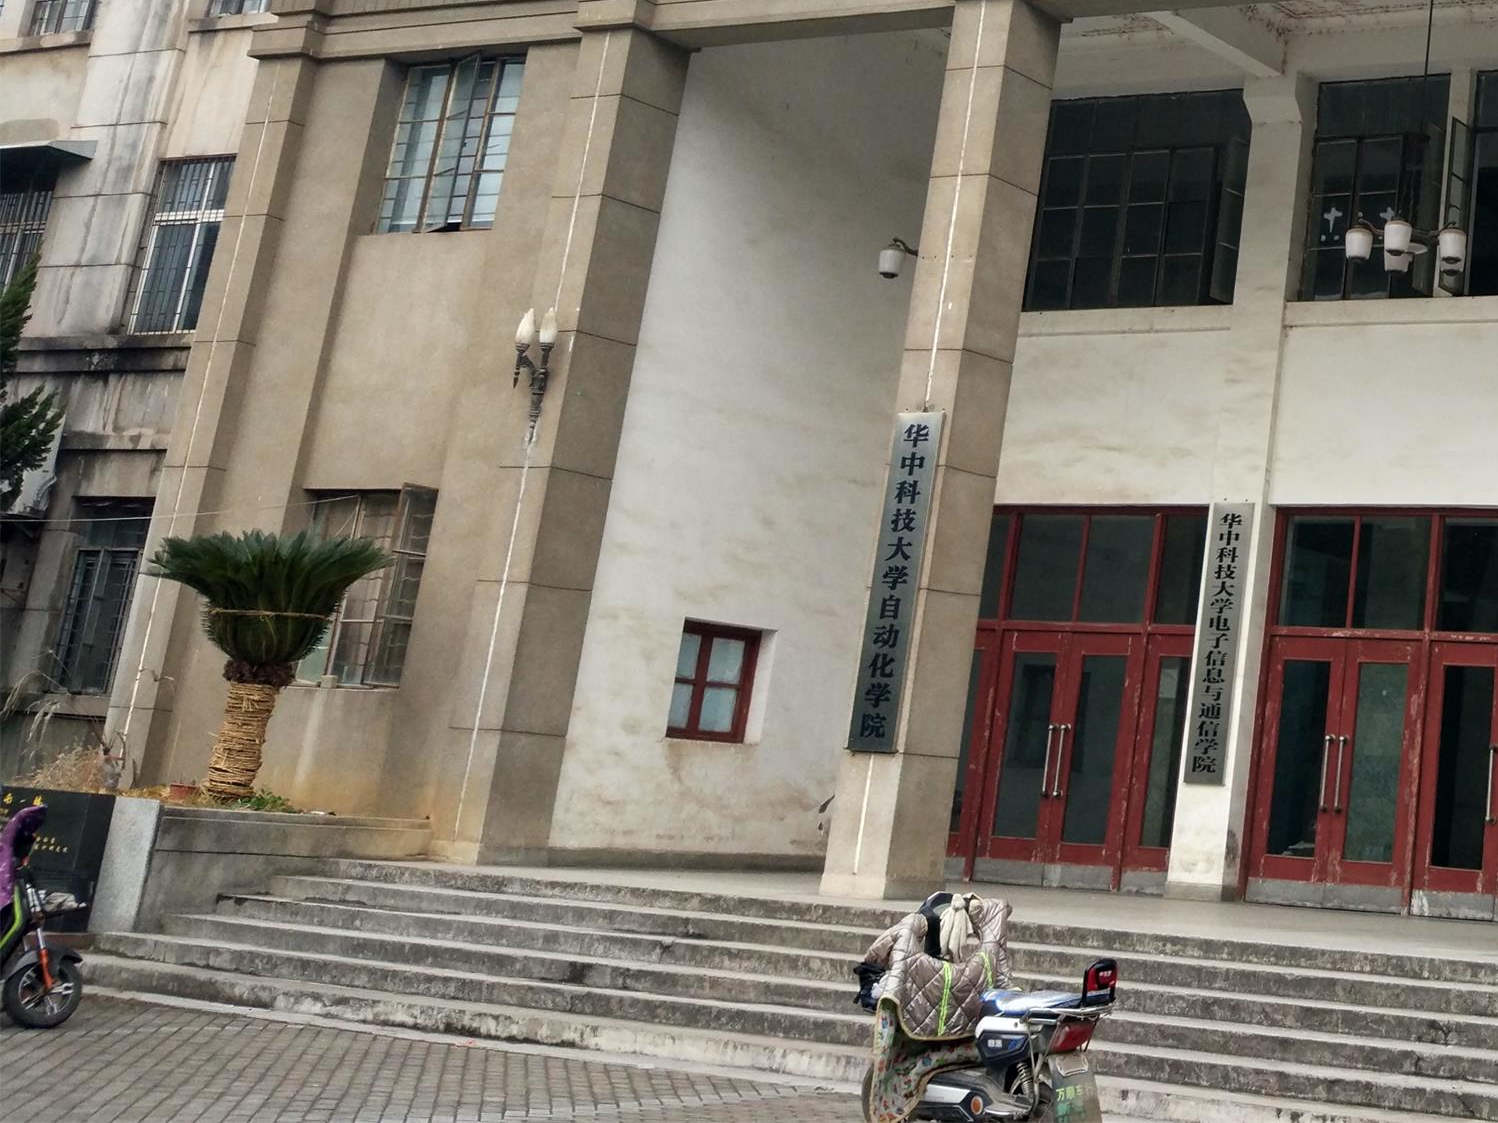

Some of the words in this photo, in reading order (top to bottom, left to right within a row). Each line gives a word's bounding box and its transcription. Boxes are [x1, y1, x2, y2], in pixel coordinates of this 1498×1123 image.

[859, 423, 930, 739] 华中科技大学自动化学院
[1190, 512, 1244, 774] 华中科技大学电子信息与通信学院
